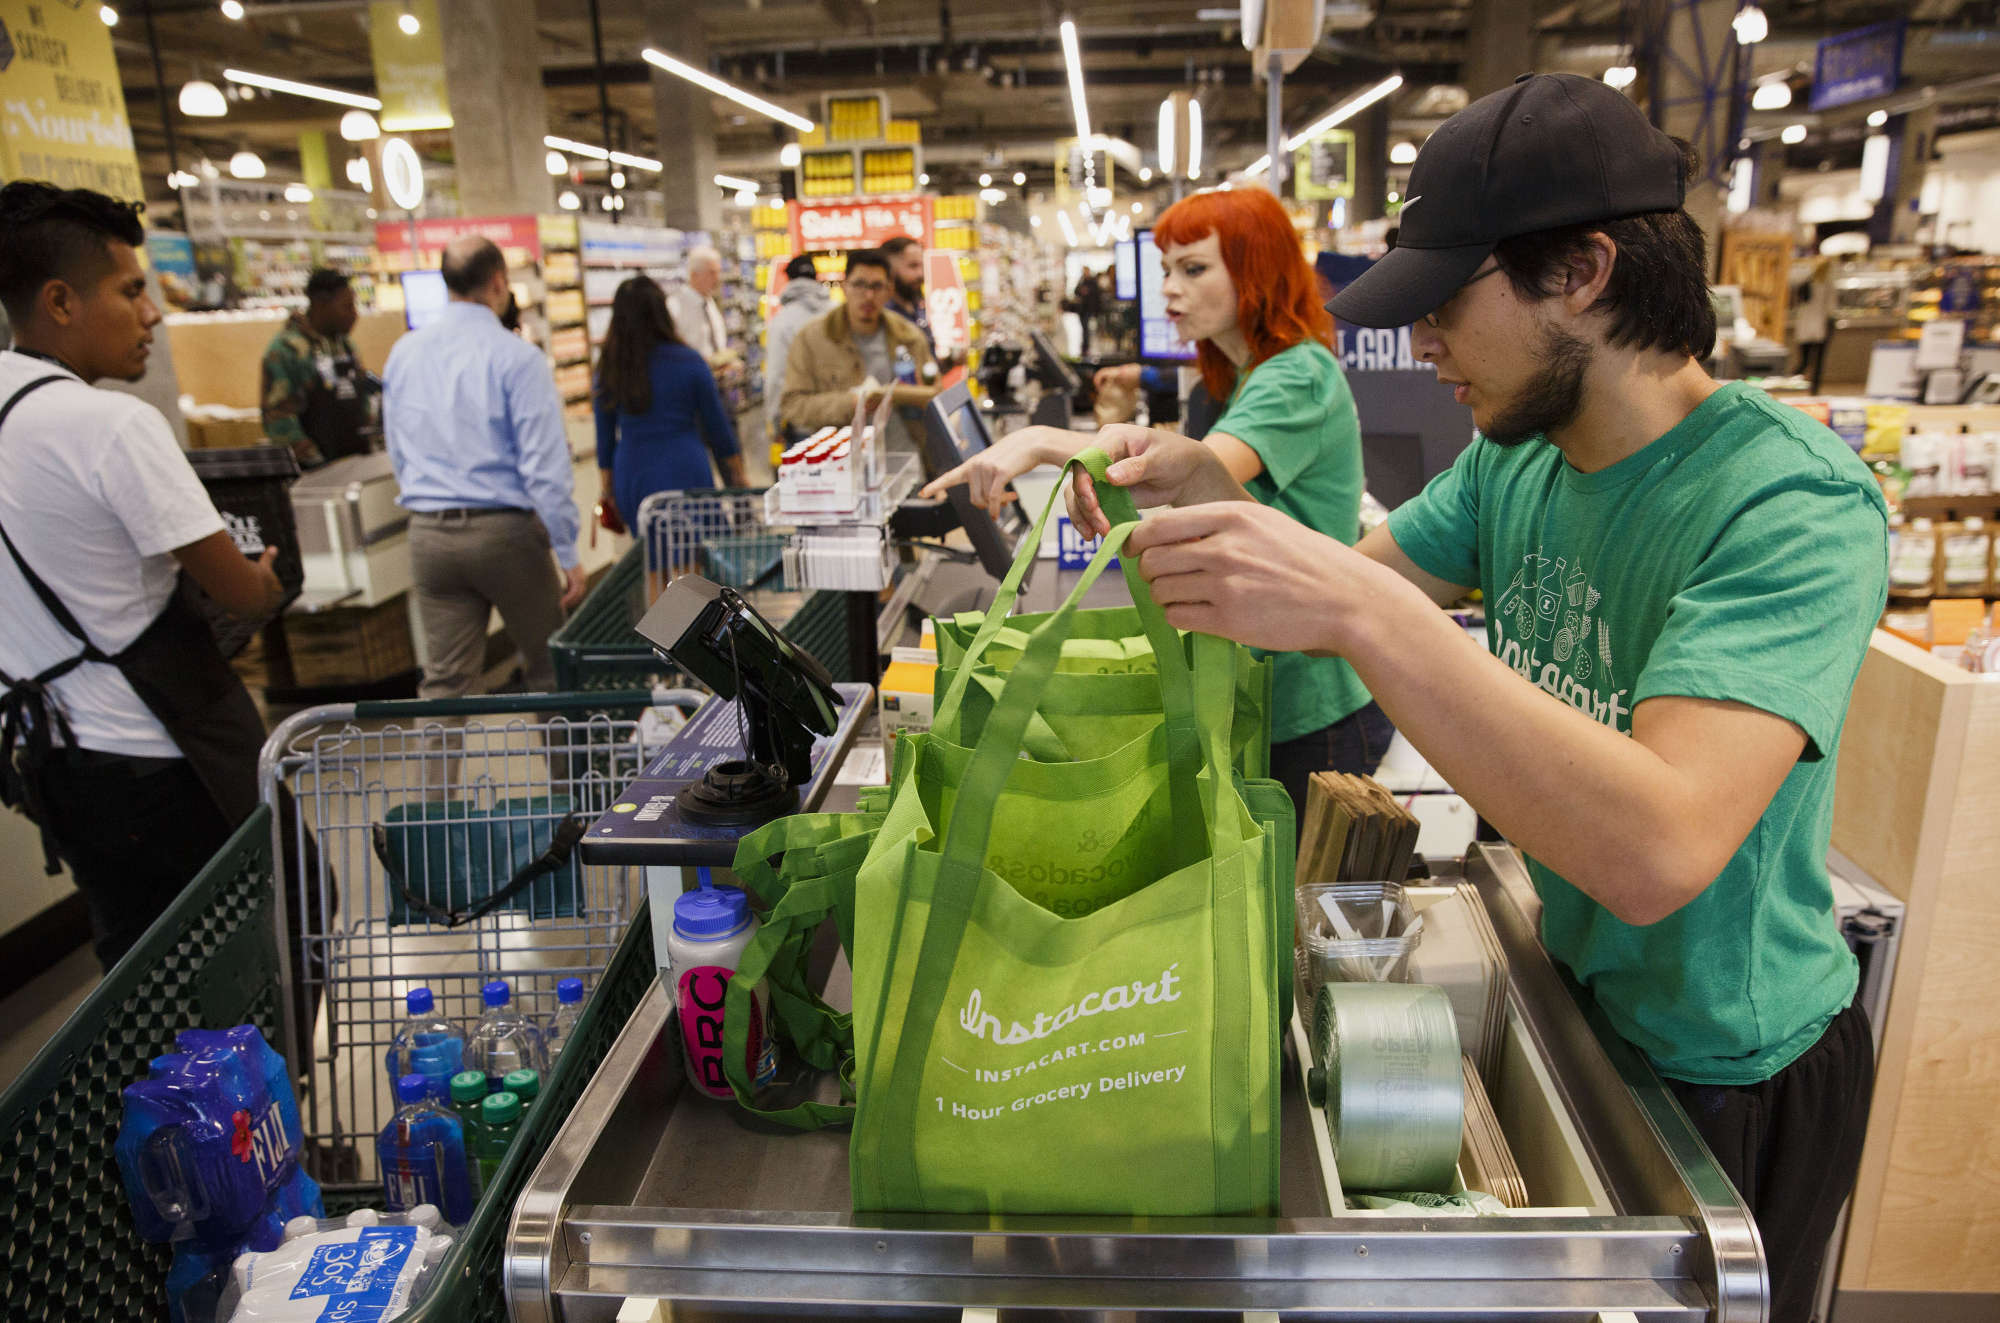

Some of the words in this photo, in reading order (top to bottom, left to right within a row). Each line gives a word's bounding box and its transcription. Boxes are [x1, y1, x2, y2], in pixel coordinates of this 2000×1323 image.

[960, 963, 1182, 1045] Instacart
[975, 1033, 1145, 1083] INSTACART.COM
[935, 1097, 944, 1112] 1
[952, 1101, 1004, 1120] Hour
[1011, 1081, 1092, 1113] Grocery
[1099, 1065, 1186, 1092] Delivery
[251, 1101, 291, 1185] FIJI
[311, 1249, 356, 1285] 365
